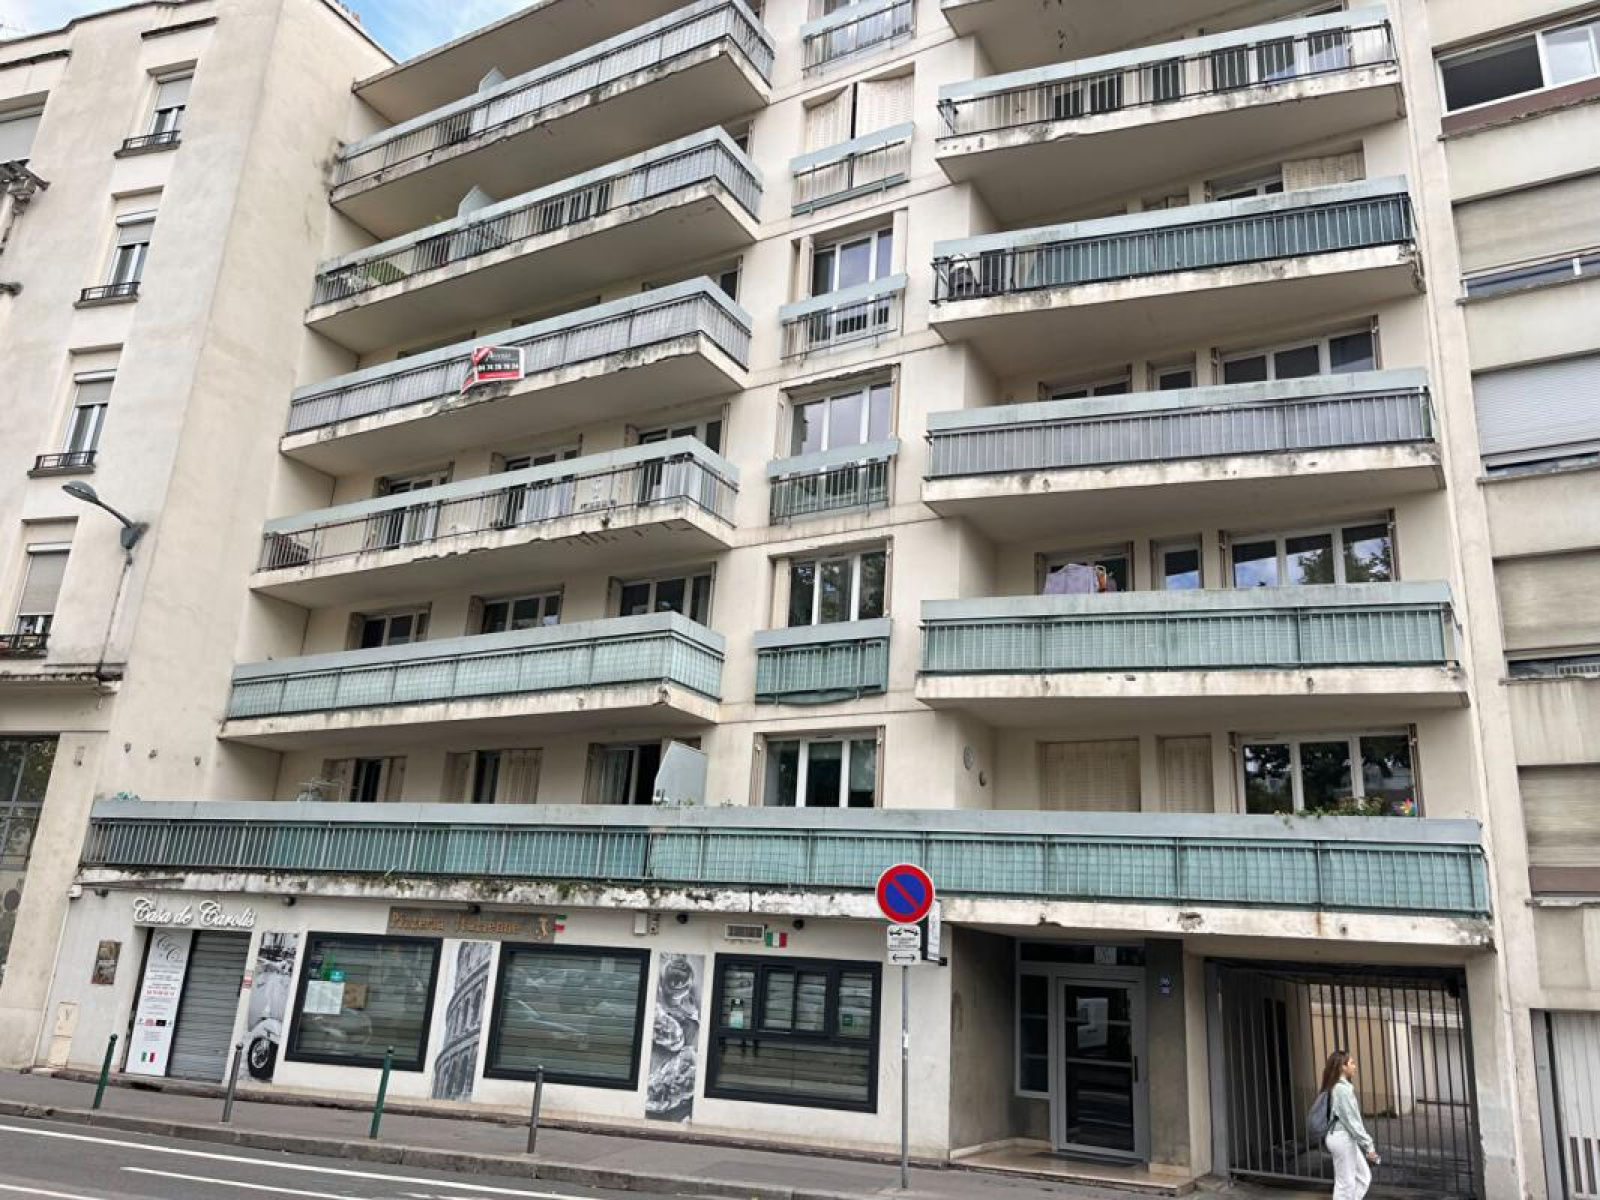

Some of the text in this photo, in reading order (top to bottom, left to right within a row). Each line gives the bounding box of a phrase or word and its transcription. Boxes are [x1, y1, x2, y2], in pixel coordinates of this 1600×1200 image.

[133, 896, 256, 928] Casa de Carolis
[391, 911, 445, 932] Pizzeria
